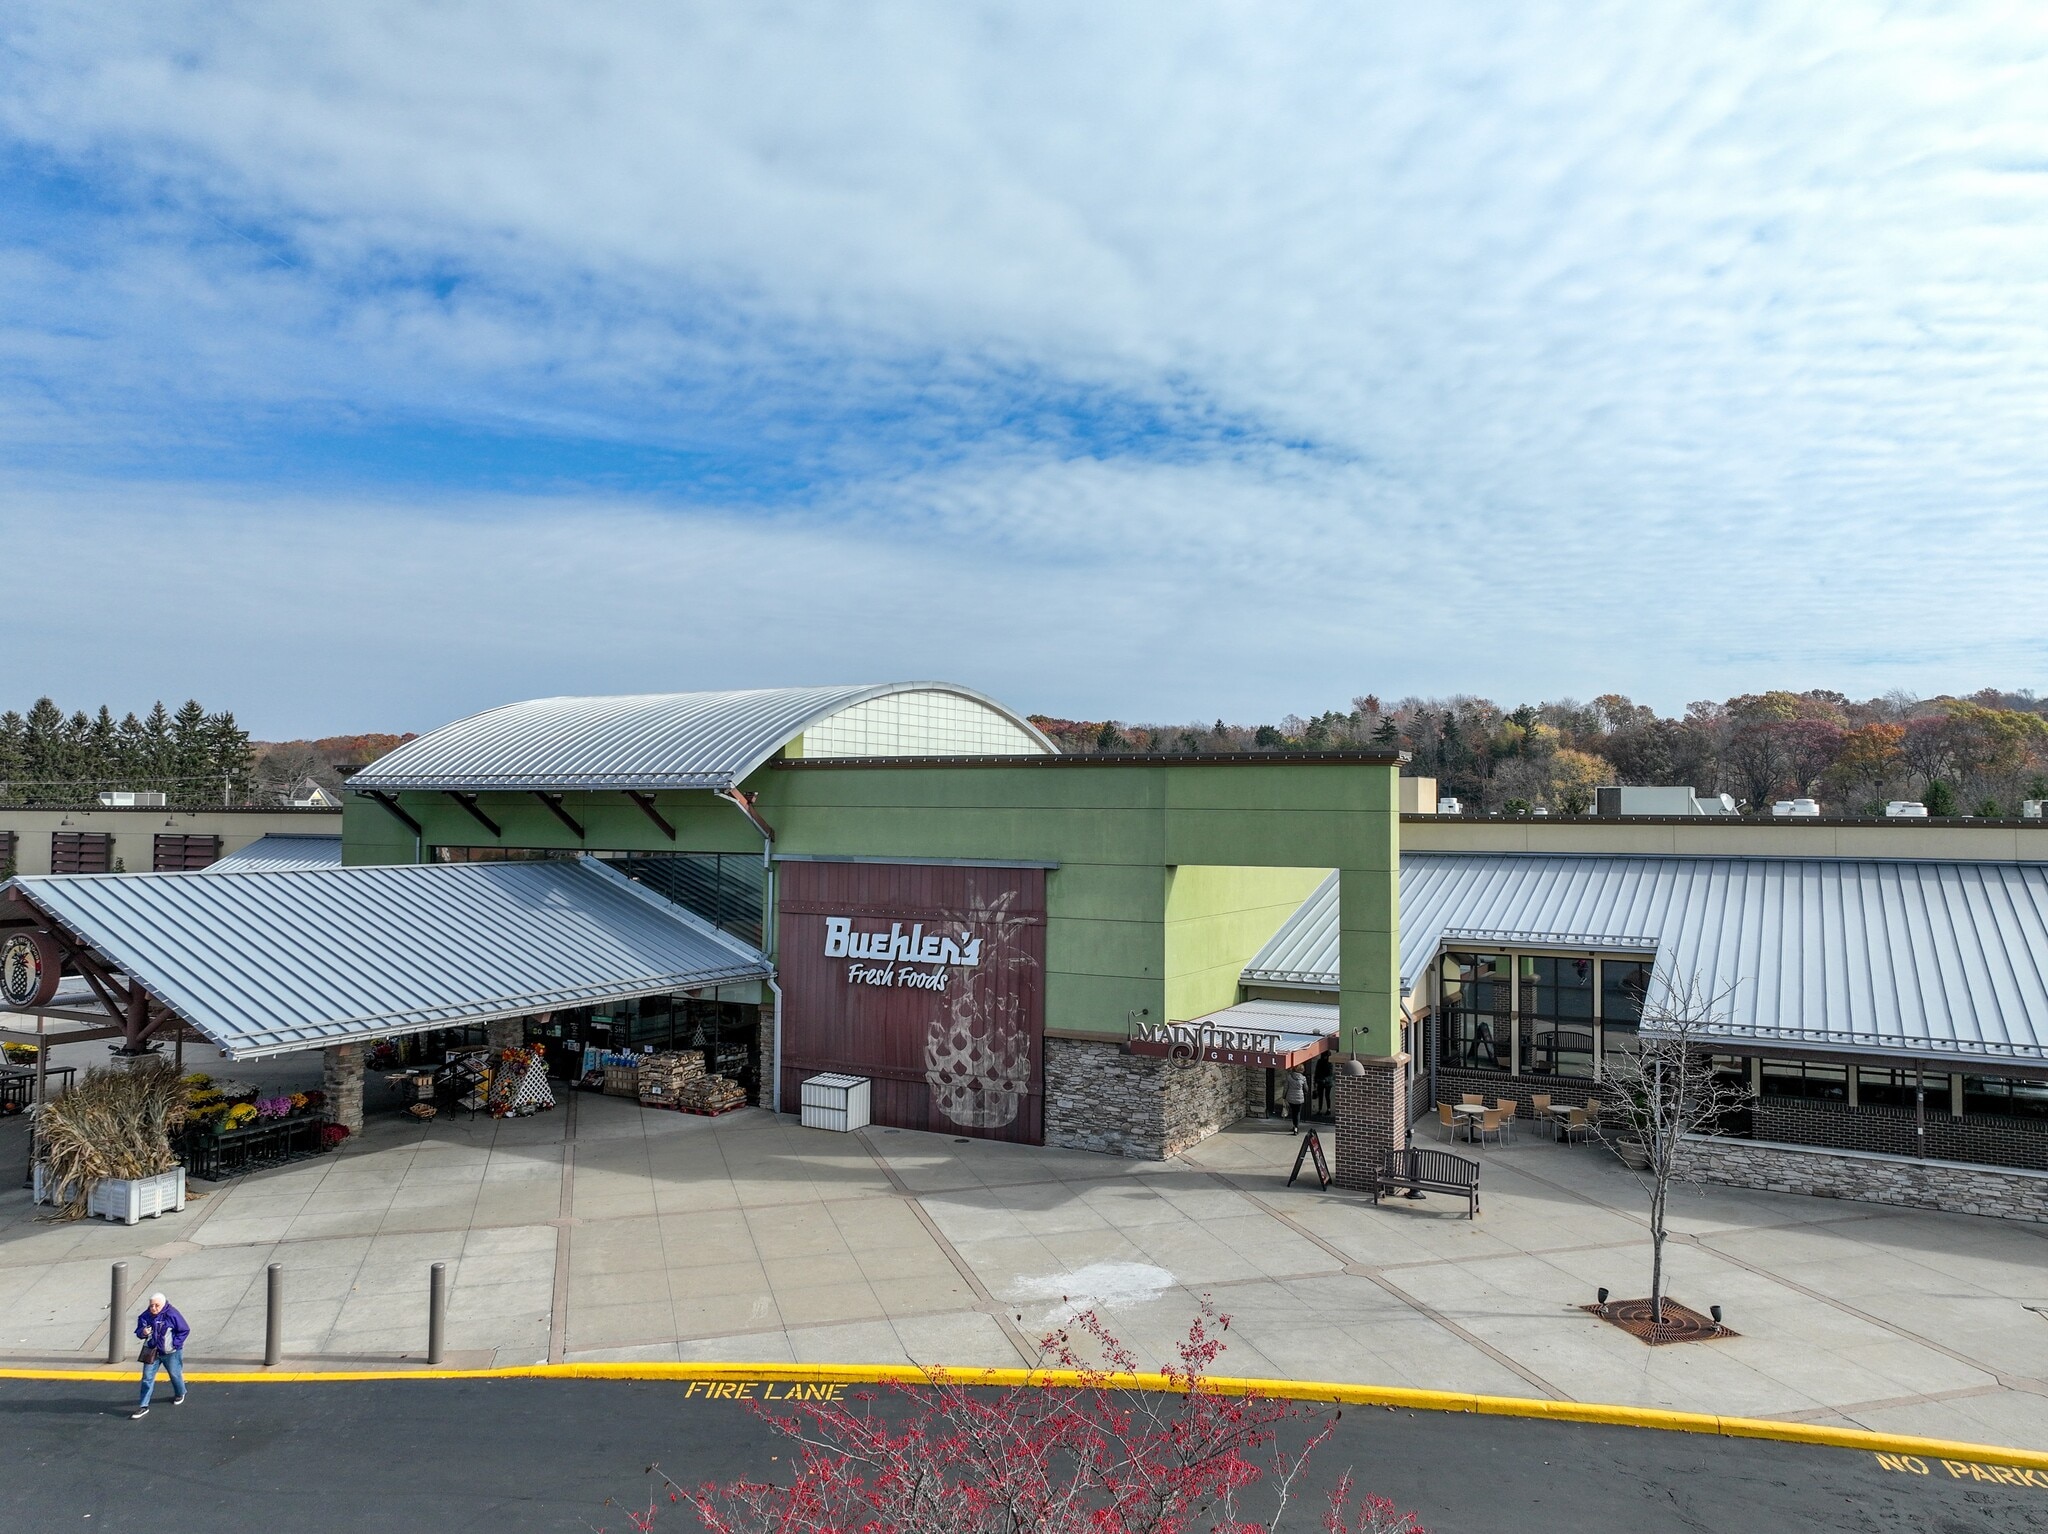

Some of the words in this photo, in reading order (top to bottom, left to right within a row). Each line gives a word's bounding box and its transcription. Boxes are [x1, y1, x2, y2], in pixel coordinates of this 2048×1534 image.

[848, 961, 893, 987] Fresh
[898, 965, 949, 991] Foods
[1136, 1021, 1199, 1047] MAIN
[1211, 1051, 1277, 1065] GRILL
[684, 1381, 759, 1399] FIRE
[764, 1383, 849, 1400] LANE
[1875, 1452, 1930, 1475] NO
